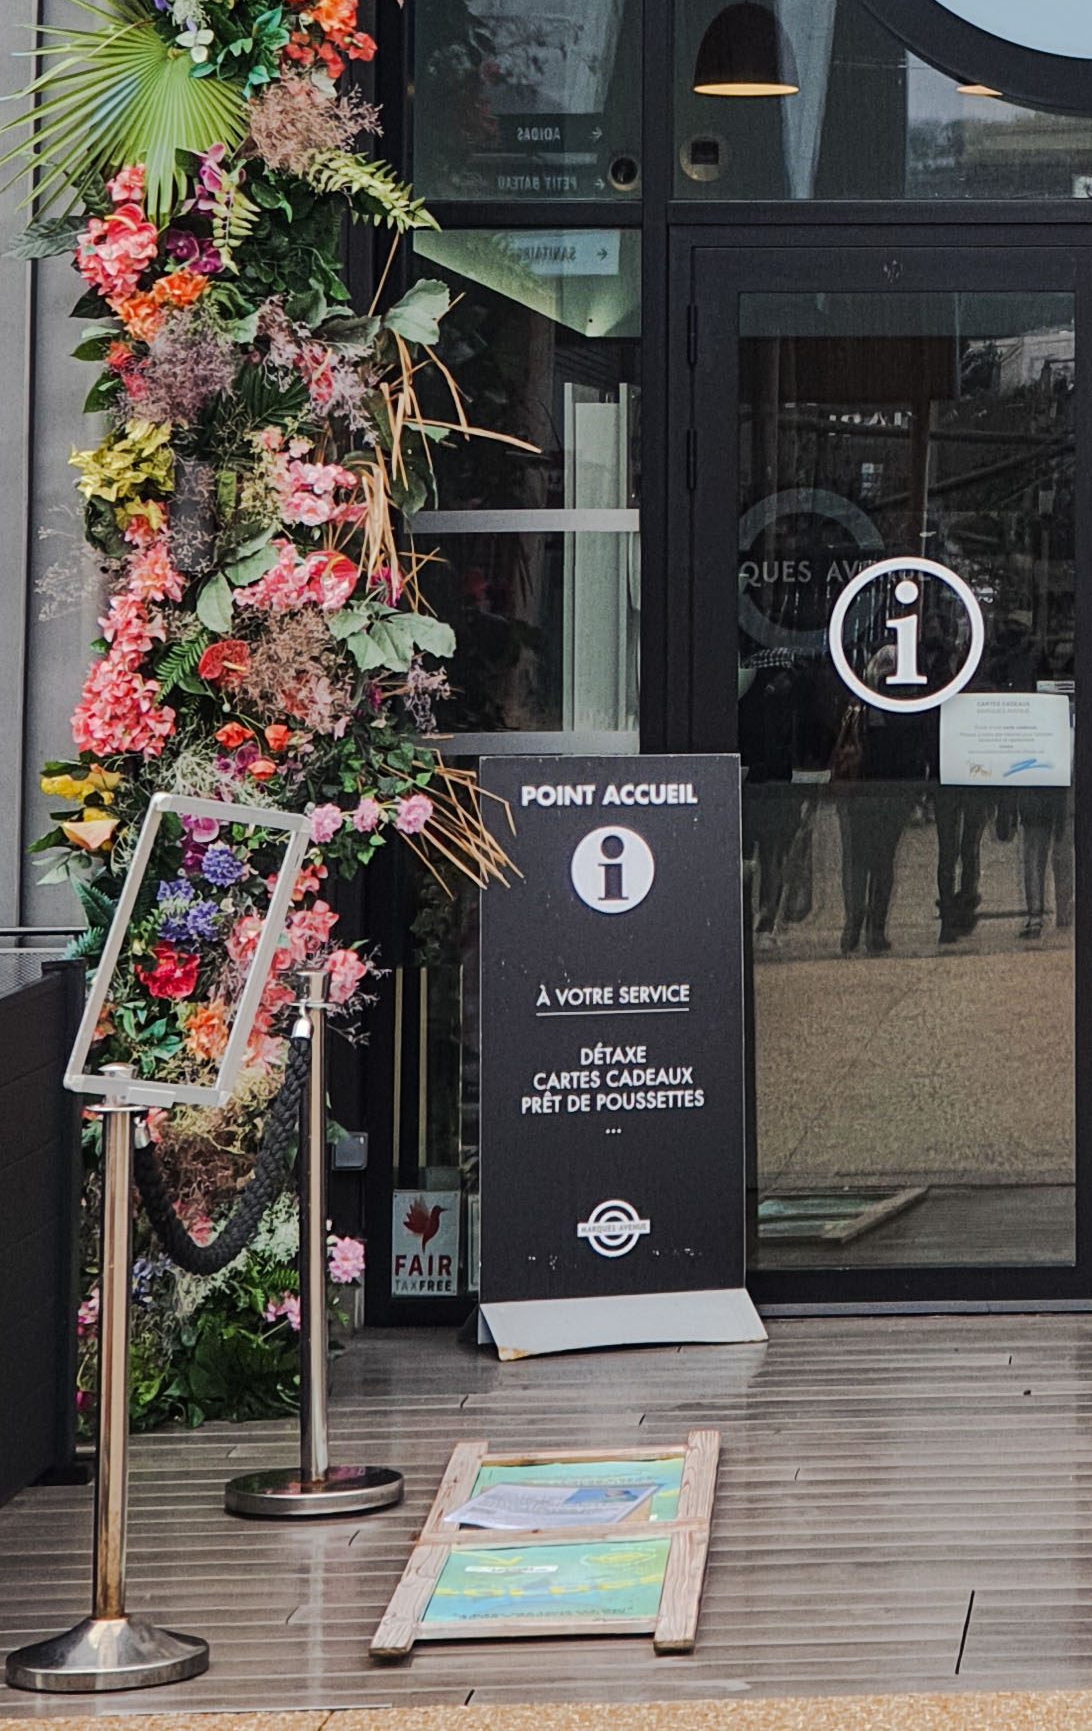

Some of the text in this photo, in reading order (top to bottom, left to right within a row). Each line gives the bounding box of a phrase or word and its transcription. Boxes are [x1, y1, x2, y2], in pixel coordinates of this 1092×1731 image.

[521, 782, 699, 807] POINT ACCUEIL
[535, 984, 690, 1007] À VOTRE SERVICE
[580, 1041, 647, 1066] DÉTAXE
[533, 1066, 694, 1091] CARTES CADEAUX
[521, 1089, 705, 1115] PRÊT DE POUSSETTES
[394, 1254, 452, 1277] FAIR
